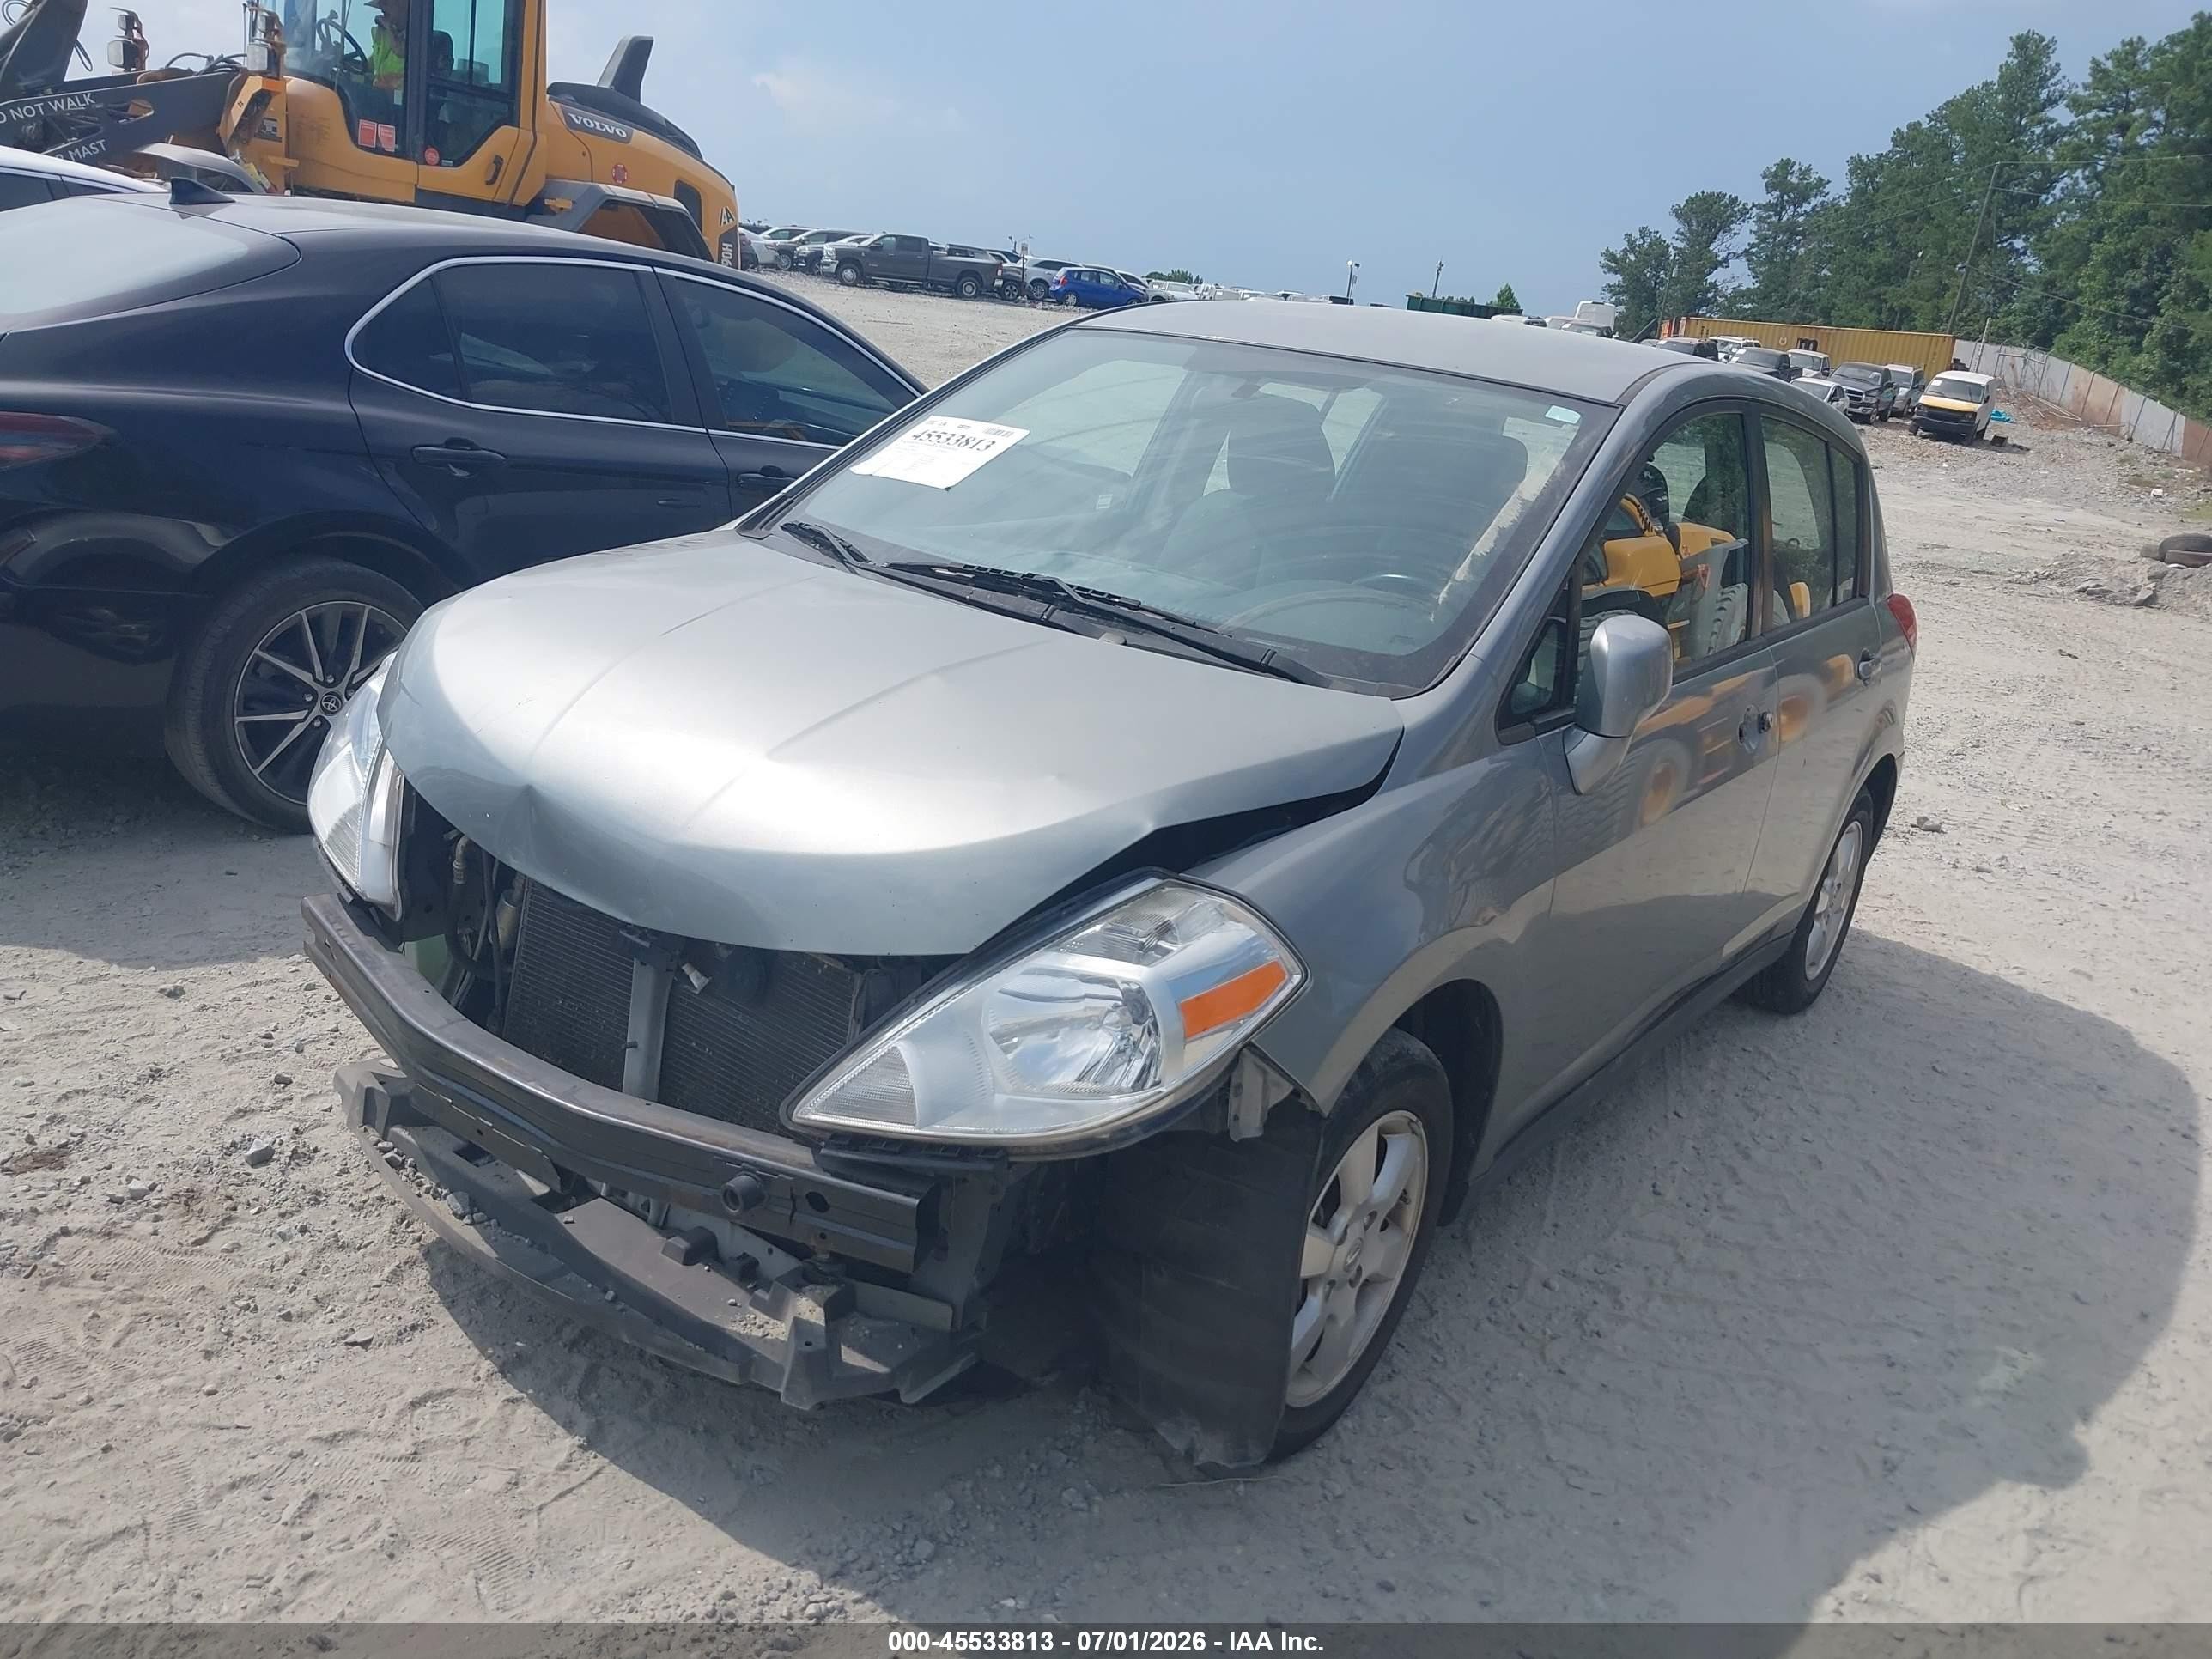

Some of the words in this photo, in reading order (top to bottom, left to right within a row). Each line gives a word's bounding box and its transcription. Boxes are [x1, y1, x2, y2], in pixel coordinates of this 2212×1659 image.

[9, 103, 45, 121] NOT
[48, 93, 96, 112] WALK
[568, 112, 627, 137] VOLVO
[68, 139, 106, 161] MAST
[912, 430, 996, 451] 45533813
